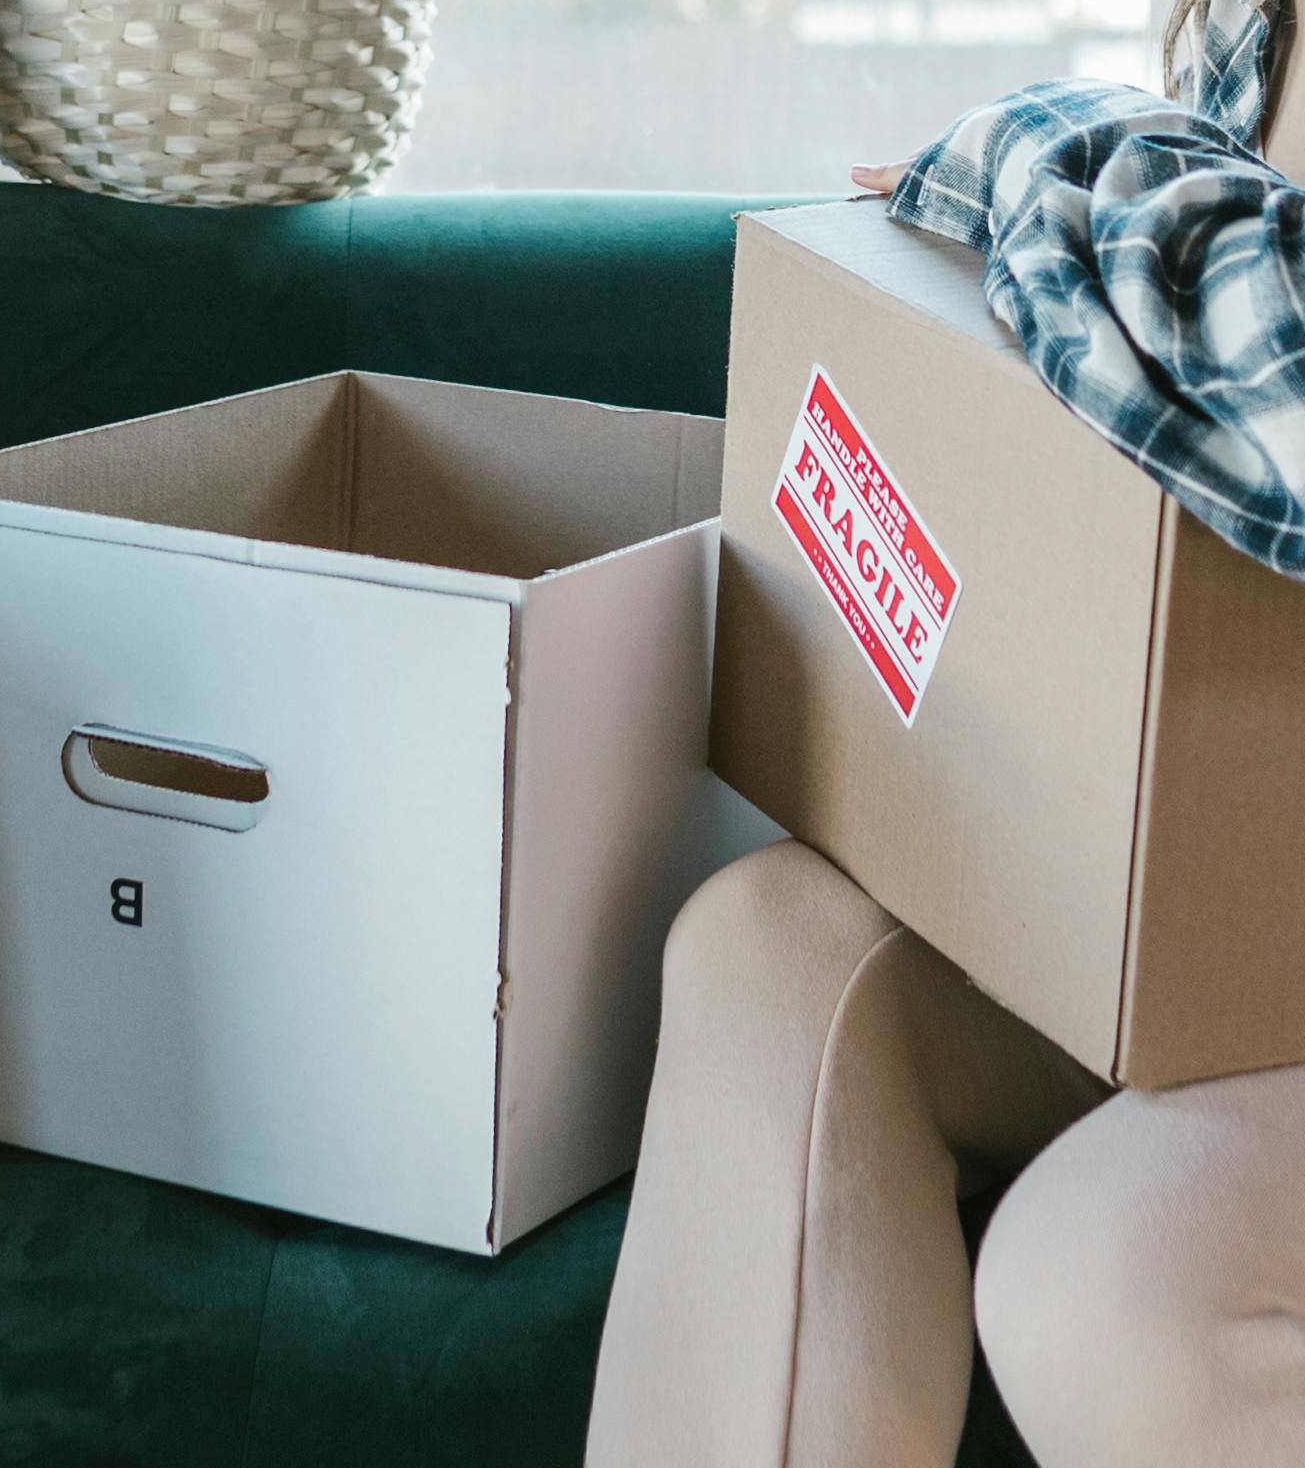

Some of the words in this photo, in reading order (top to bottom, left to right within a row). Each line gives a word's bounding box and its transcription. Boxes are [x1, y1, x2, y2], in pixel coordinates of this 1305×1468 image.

[811, 401, 866, 491] HANDLE
[868, 485, 905, 550] WITH
[905, 547, 944, 611] CARE
[856, 447, 908, 531] PLEASE
[795, 439, 928, 664] FRAGILE
[822, 560, 849, 608] THANK
[848, 604, 866, 636] YOU
[110, 877, 143, 927] B
